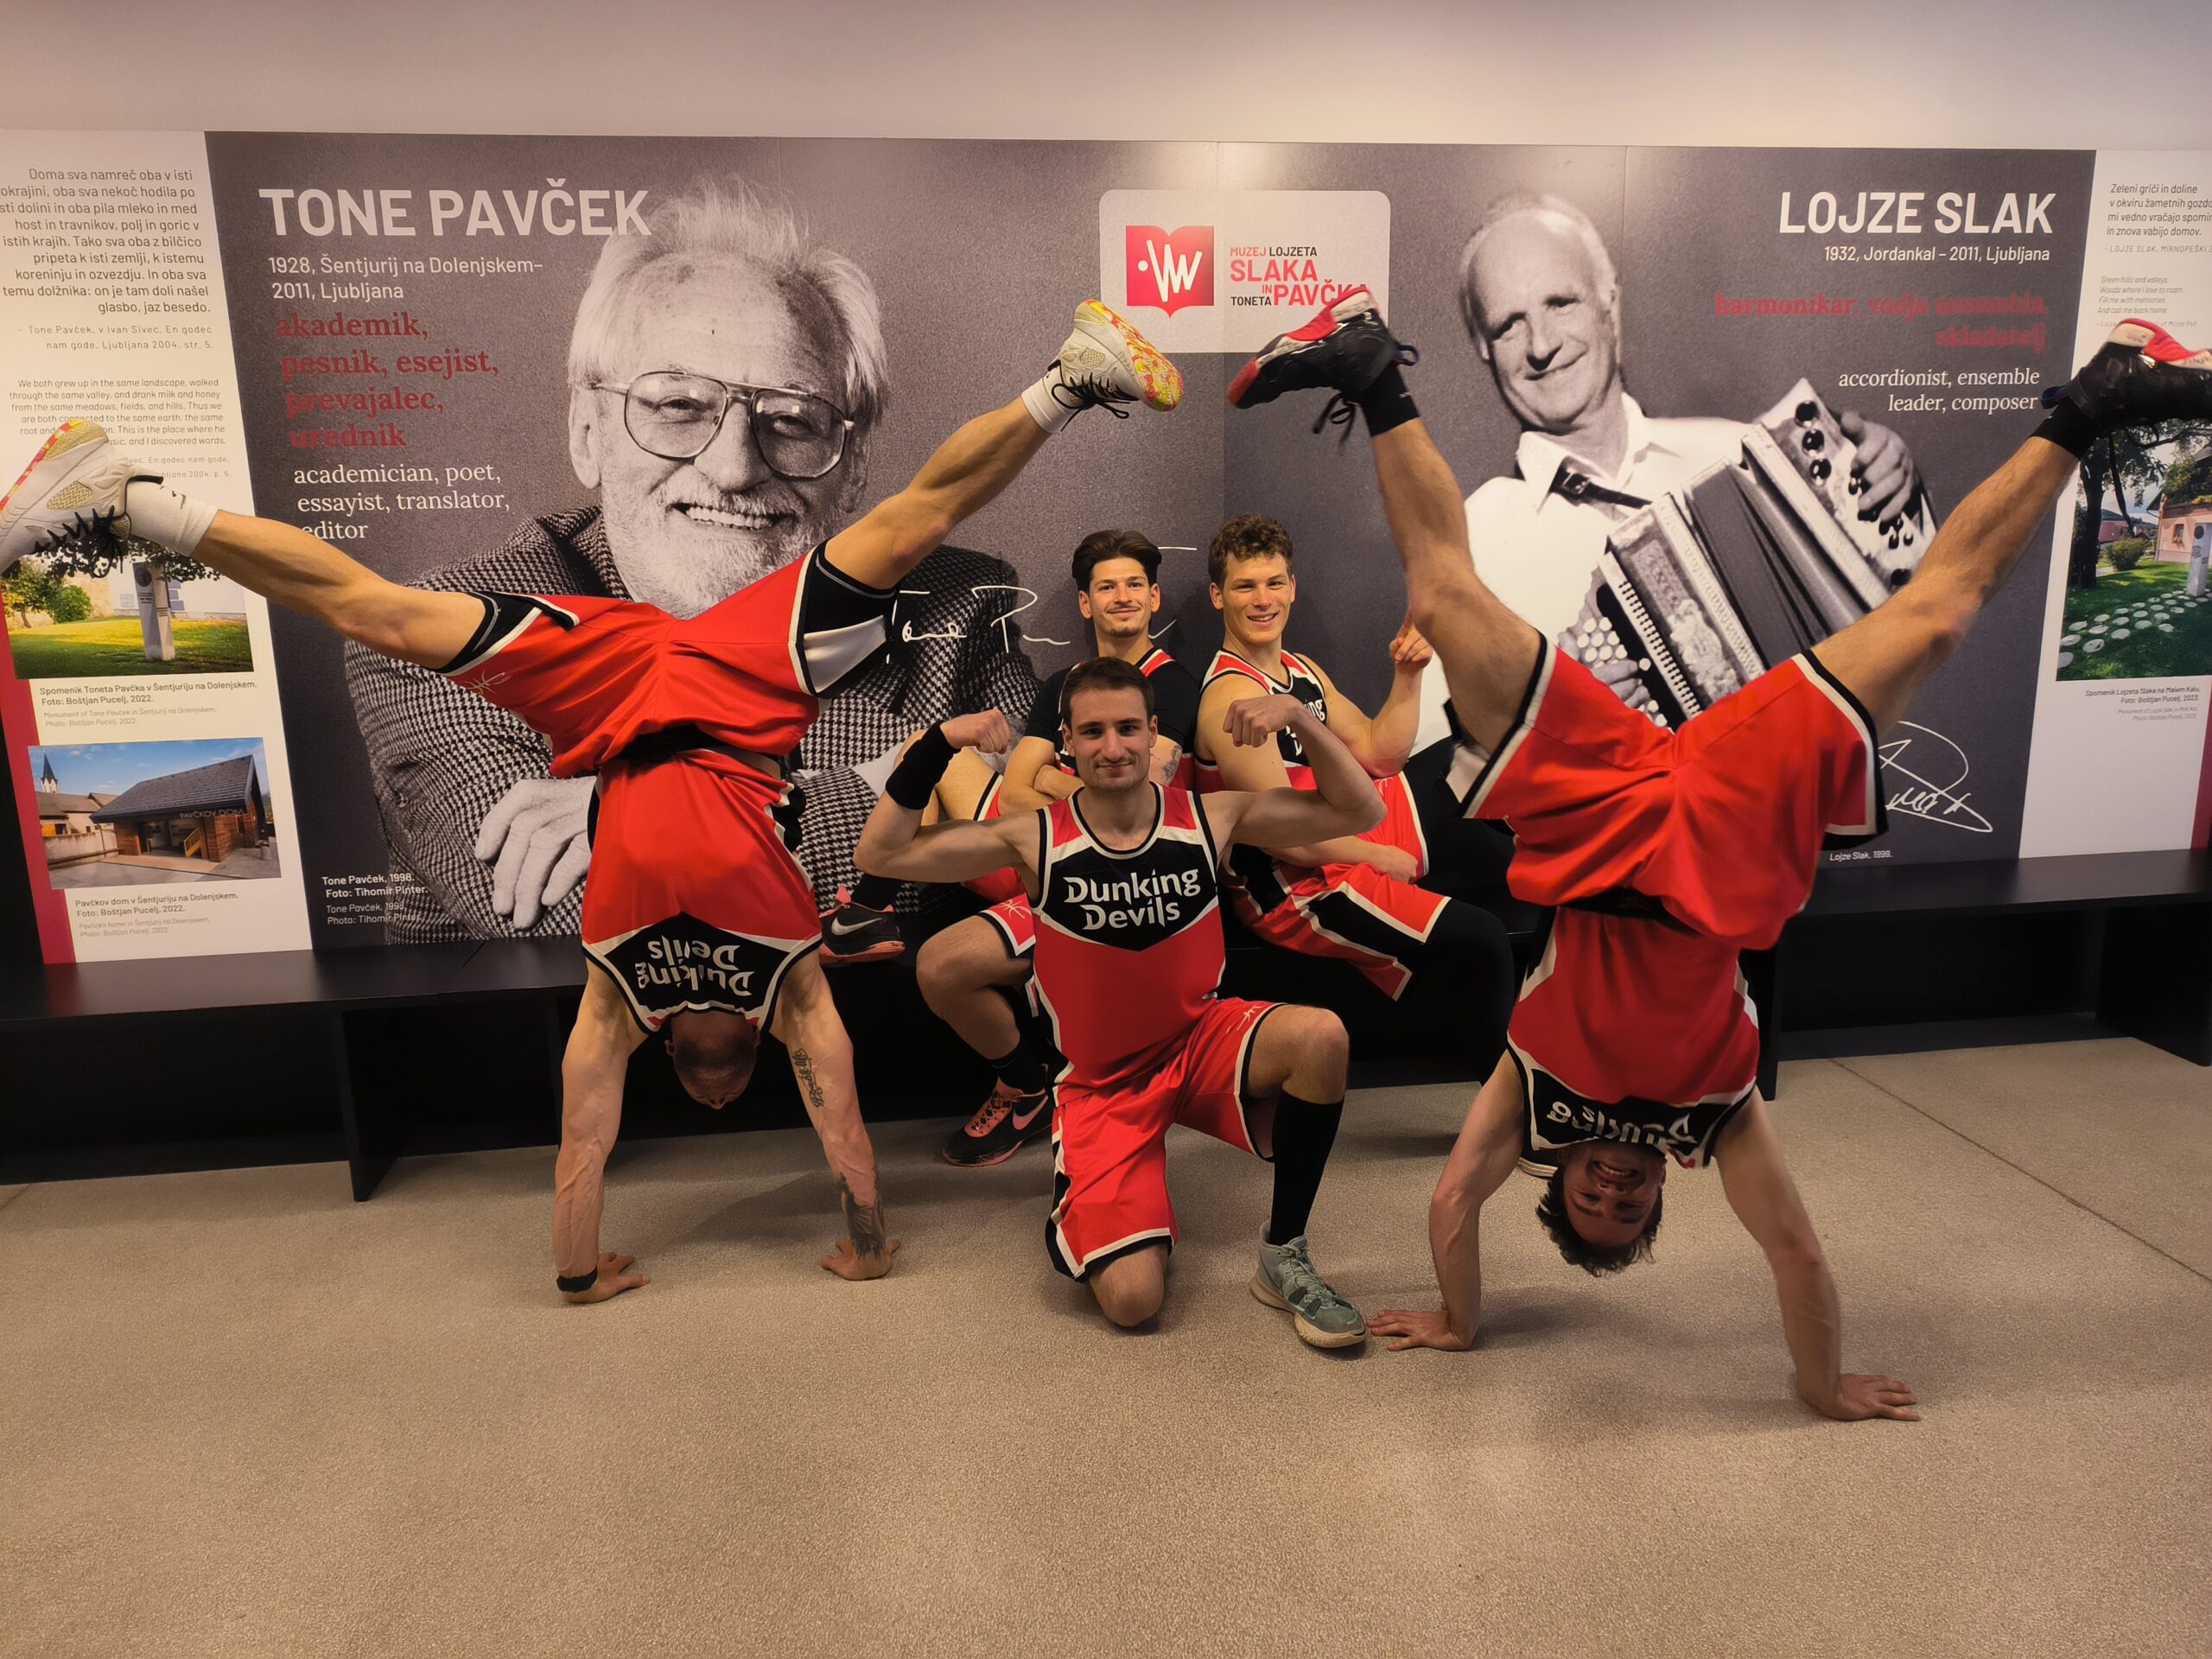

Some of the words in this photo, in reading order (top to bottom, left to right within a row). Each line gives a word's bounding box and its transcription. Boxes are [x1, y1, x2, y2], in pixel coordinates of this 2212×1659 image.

[29, 168, 65, 180] Doma
[67, 171, 87, 180] sva
[90, 168, 137, 180] namreč
[139, 169, 162, 180] oba
[174, 169, 192, 181] isti
[0, 185, 49, 199] okrajini,
[53, 186, 75, 196] oba
[78, 188, 98, 197] sva
[101, 186, 137, 197] nekoč
[140, 186, 177, 197] hodila
[180, 188, 194, 200] po
[2110, 183, 2138, 193] Zeleni
[2139, 183, 2159, 195] griči
[2160, 184, 2169, 193] in
[2171, 184, 2197, 194] doline
[17, 201, 50, 213] dolini
[54, 202, 65, 213] in
[67, 202, 90, 213] oba
[93, 202, 114, 215] pila
[118, 202, 154, 213] mleko
[156, 202, 168, 213] in
[170, 203, 197, 213] med
[258, 188, 416, 236] TONE
[429, 177, 652, 237] PAVČEK
[2116, 198, 2143, 207] okviru
[2145, 198, 2185, 207] žametnih
[1779, 191, 1924, 233] LOJZE
[1934, 192, 2056, 233] SLAK
[2107, 212, 2119, 220] mi
[2120, 212, 2146, 221] vedno
[2149, 212, 2180, 224] vračajo
[15, 219, 41, 230] host
[44, 219, 56, 230] in
[59, 219, 118, 230] travnikov,
[121, 219, 142, 232] polj
[144, 219, 156, 230] in
[159, 219, 190, 232] goric
[2107, 226, 2114, 235] in
[2143, 226, 2168, 238] vabijo
[2171, 226, 2201, 235] domov.
[3, 235, 29, 246] istih
[32, 235, 70, 249] krajih.
[73, 235, 102, 246] Tako
[128, 236, 149, 246] oba
[162, 236, 201, 246] bilčico
[33, 252, 77, 265] pripeta
[79, 252, 86, 263] k
[89, 251, 108, 263] isti
[111, 251, 149, 265] zemlji,
[152, 252, 160, 263] k
[162, 252, 204, 263] istemu
[1230, 247, 1265, 256] MUZEJ
[1269, 246, 1317, 256] LOJZETA
[1824, 246, 1859, 262] 1932,
[1863, 246, 1936, 260] Jordankal
[1948, 246, 1981, 262] 2011,
[1986, 246, 2050, 264] Ljubljana
[268, 257, 315, 275] 1928,
[320, 253, 397, 277] Šentjurij
[403, 261, 424, 273] na
[1230, 259, 1318, 282] SLAKA
[15, 268, 72, 282] koreninju
[74, 268, 86, 279] in
[89, 269, 144, 282] ozvezdju.
[147, 269, 158, 279] In
[162, 269, 183, 279] oba
[3, 286, 34, 296] temu
[37, 284, 91, 296] dolžnika:
[94, 287, 109, 296] on
[111, 284, 123, 298] je
[125, 286, 149, 296] tam
[152, 284, 174, 296] doli
[176, 285, 208, 296] našel
[271, 282, 315, 300] 2011,
[320, 282, 404, 302] Ljubljana
[1262, 284, 1272, 294] IN
[98, 302, 140, 315] glasbo,
[143, 301, 161, 315] jaz
[162, 302, 210, 312] besedo.
[1230, 296, 1271, 306] TONETA
[1870, 292, 1929, 321] vodja
[276, 312, 429, 339] akademik,
[1936, 324, 2044, 352] skladatelj
[280, 349, 387, 383] pesnik,
[396, 351, 498, 380] esejist,
[54, 380, 76, 389] grew
[78, 380, 88, 389] up
[1838, 368, 1951, 387] accordionist,
[1957, 367, 2039, 385] ensemble
[285, 386, 442, 420] prevajalec,
[1888, 394, 1946, 413] leader,
[1951, 397, 2038, 415] composer
[289, 423, 406, 448] urednik
[294, 463, 438, 484] academician,
[444, 464, 500, 486] poet,
[297, 494, 390, 517] essayist,
[396, 493, 510, 512] translator,
[302, 520, 368, 539] editor
[39, 686, 82, 696] Spomenik
[153, 682, 194, 692] Šentjuriju
[207, 681, 257, 690] Dolenjskem.
[321, 876, 346, 885] Tone
[348, 874, 387, 884] Pavček,
[390, 873, 415, 882] 1998.
[1063, 868, 1201, 905] Dunking
[326, 889, 352, 898] Foto:
[354, 886, 394, 896] Tihomir
[395, 886, 429, 894] Pinter.
[1080, 897, 1180, 931] Devils
